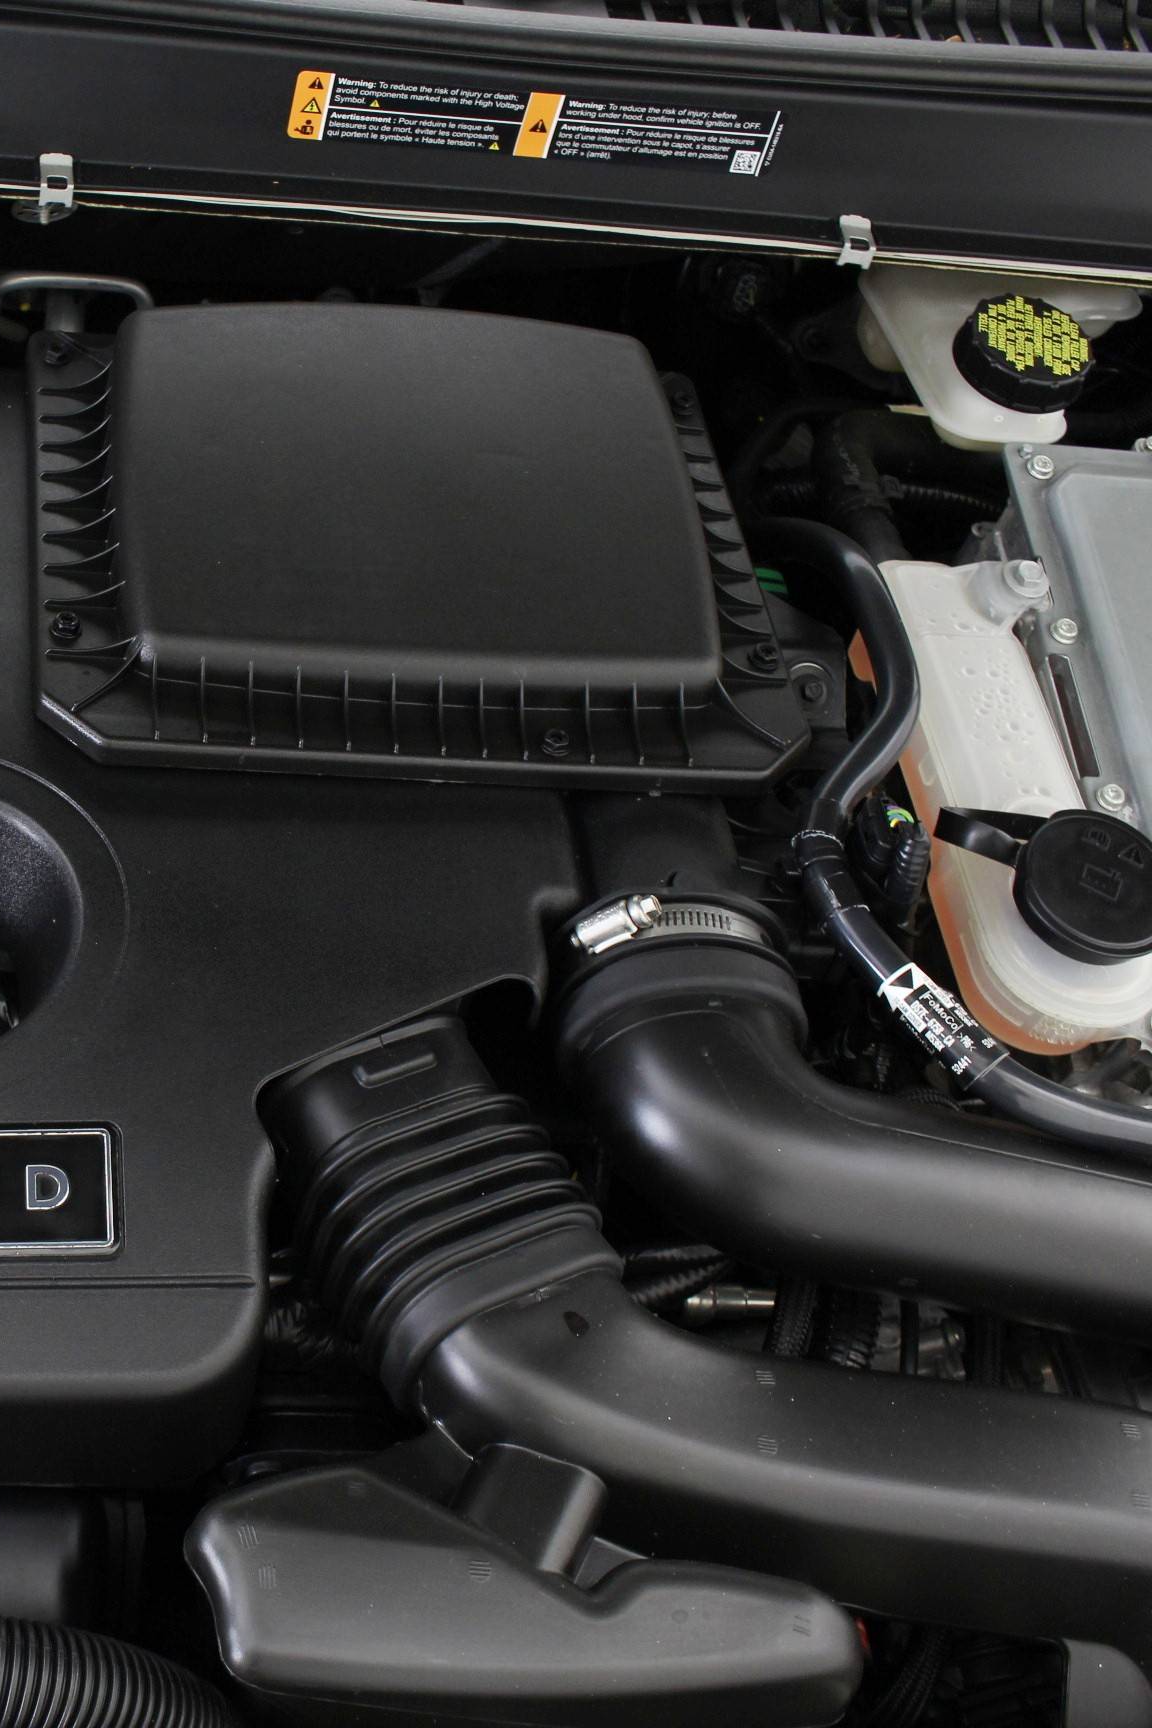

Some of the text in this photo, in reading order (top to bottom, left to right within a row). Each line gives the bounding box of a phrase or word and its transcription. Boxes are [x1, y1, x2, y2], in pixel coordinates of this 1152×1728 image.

[338, 78, 376, 89] Warning:
[390, 83, 418, 92] reduce
[434, 86, 448, 94] risk
[450, 88, 460, 96] of
[460, 89, 482, 98] injury
[334, 95, 366, 104] Symbol.
[336, 87, 358, 95] avoid
[360, 90, 408, 100] components
[410, 94, 440, 102] marked
[442, 96, 458, 104] with
[474, 99, 493, 108] High
[496, 101, 524, 110] Voltage
[566, 110, 596, 118] working
[677, 118, 704, 126] vehicle
[705, 120, 732, 128] ignition
[743, 122, 761, 130] OFF.
[569, 100, 606, 110] Warning:
[620, 105, 646, 113] reduce
[712, 112, 737, 120] before
[329, 121, 366, 130] blessures
[415, 127, 436, 135] éviter
[452, 131, 499, 140] composants
[330, 112, 391, 124] Avertissement
[458, 123, 481, 131] risque
[380, 134, 413, 142] symbole
[422, 136, 446, 144] Haute
[561, 124, 620, 135] Avertissement
[646, 131, 672, 139] réduire
[683, 134, 706, 142] risque
[719, 137, 755, 145] blessures
[924, 993, 958, 1030] FoMoCo
